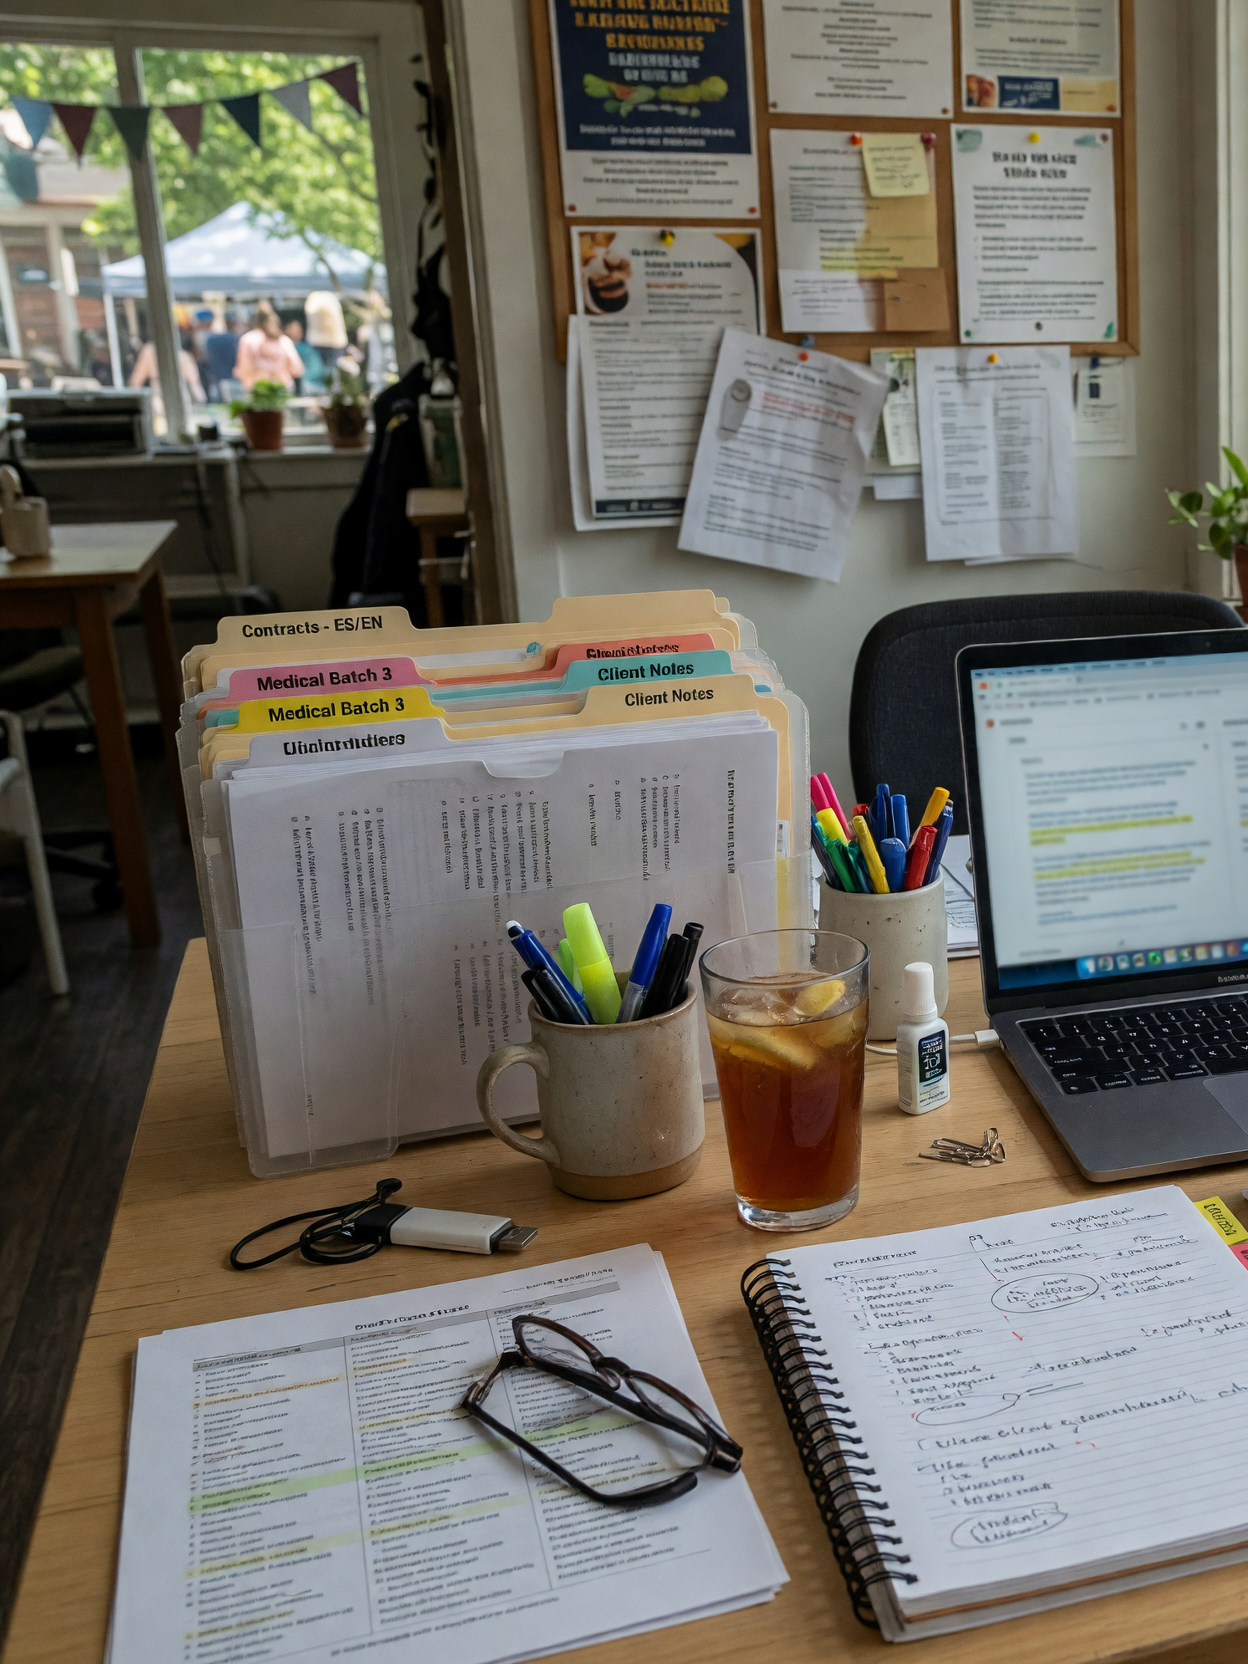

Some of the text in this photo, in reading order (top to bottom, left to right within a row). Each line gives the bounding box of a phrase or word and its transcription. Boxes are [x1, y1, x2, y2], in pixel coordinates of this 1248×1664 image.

[242, 621, 320, 638] Contracts
[334, 615, 383, 632] ES/EN
[257, 667, 392, 691] Medical Batch 3
[598, 662, 694, 681] Client Notes
[625, 688, 714, 706] Client Notes
[268, 697, 405, 722] Medical Batch 3
